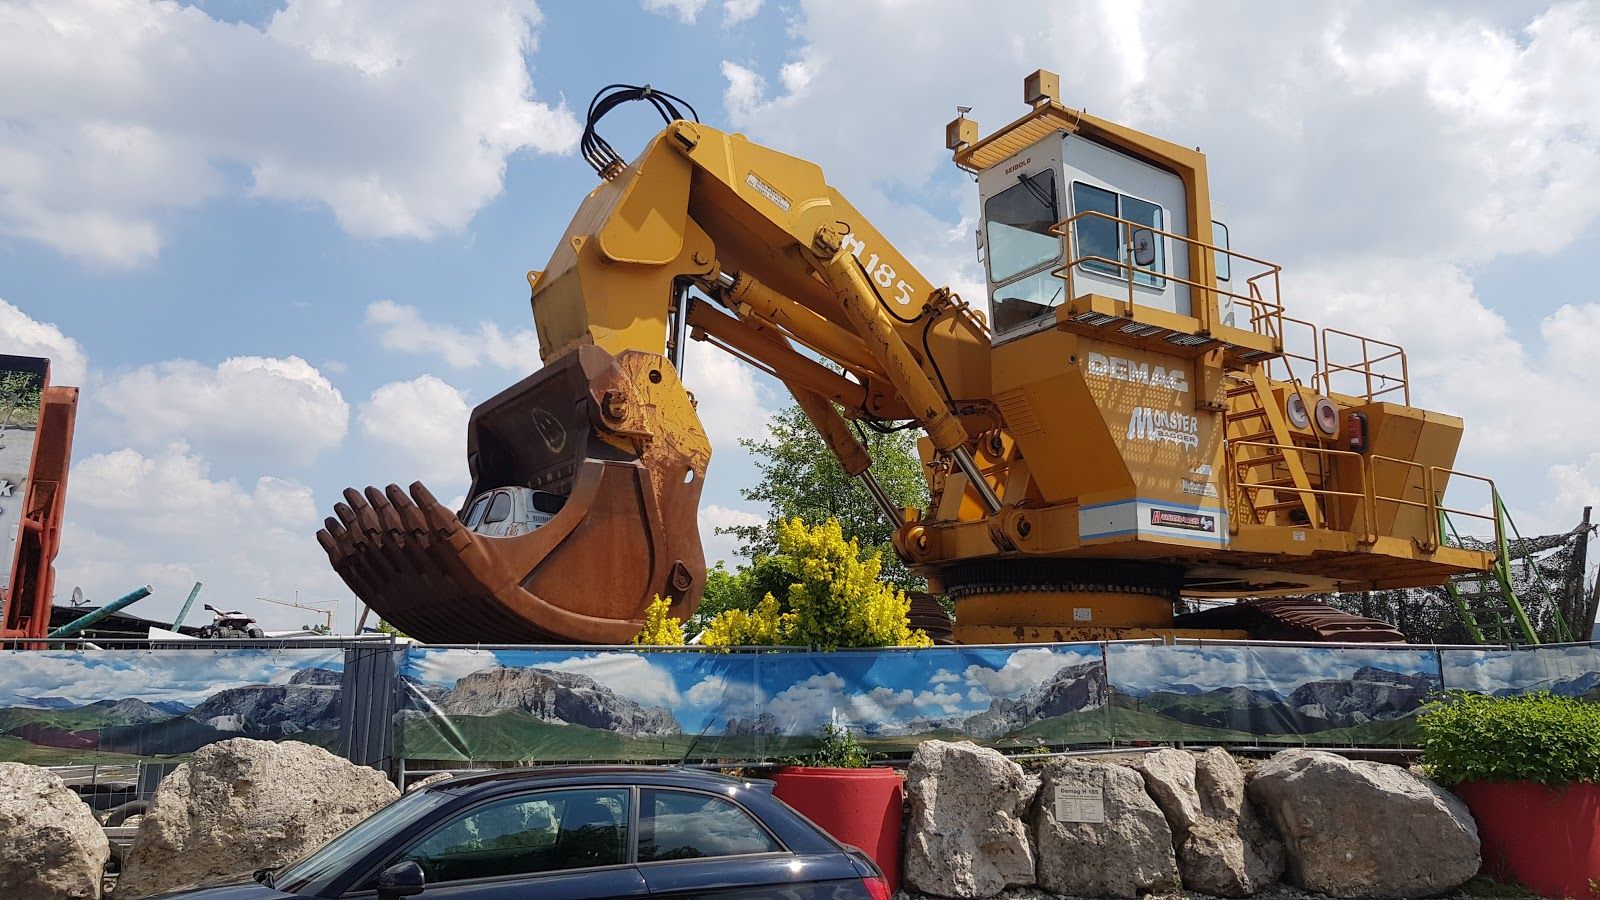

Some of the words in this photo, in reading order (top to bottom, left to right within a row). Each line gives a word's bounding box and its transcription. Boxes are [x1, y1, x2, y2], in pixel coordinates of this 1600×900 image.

[1004, 157, 1032, 175] SEIBOLD
[1088, 352, 1189, 393] DEMAG
[1127, 407, 1198, 441] MONSTER
[1157, 430, 1196, 443] BAGGER
